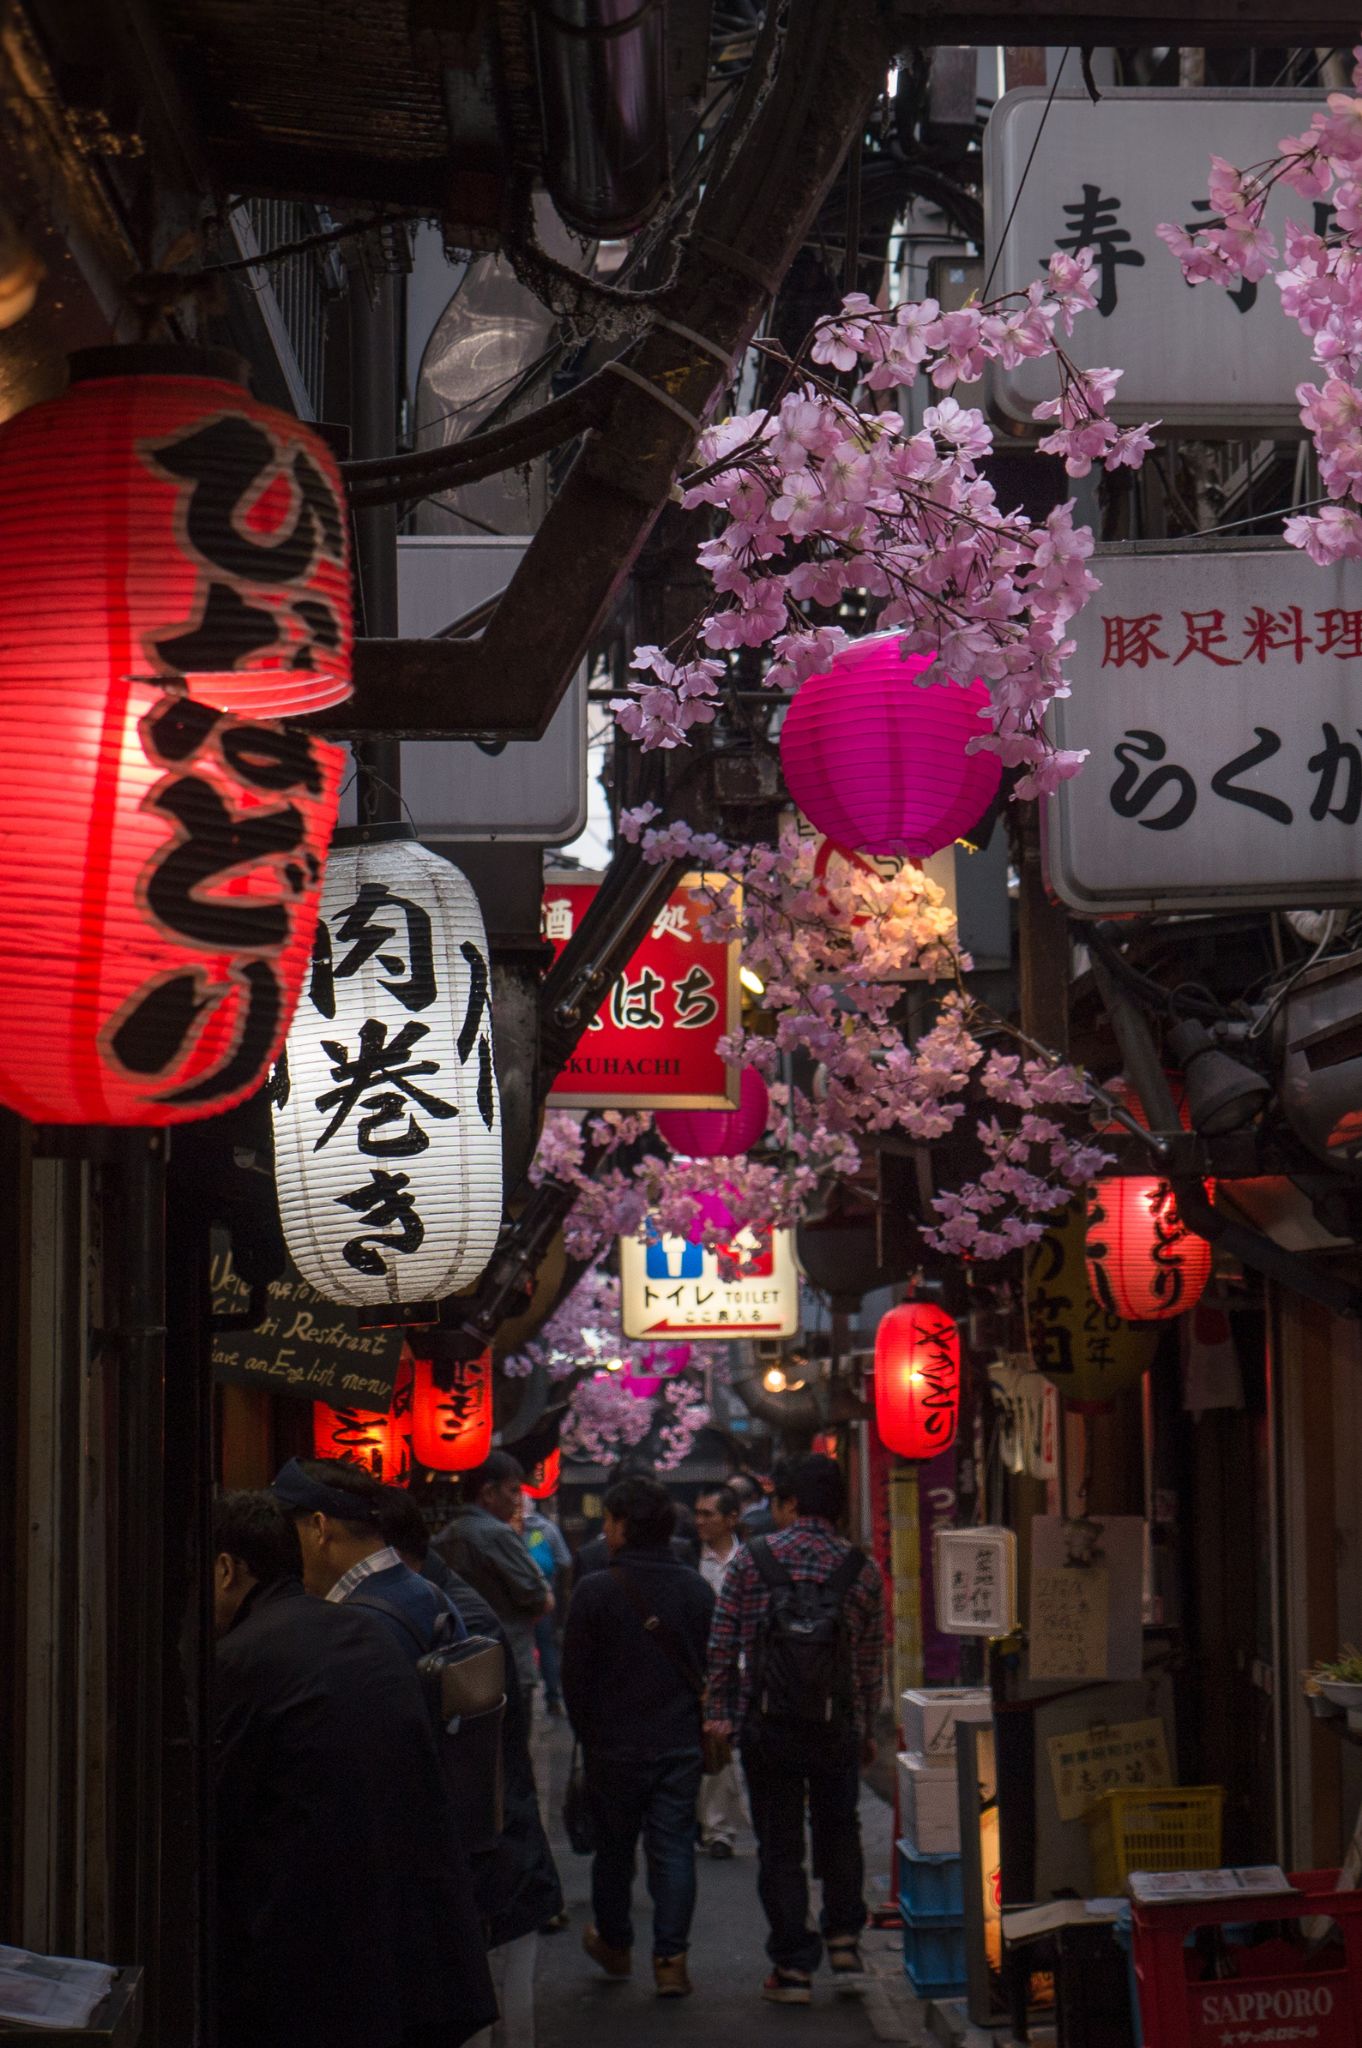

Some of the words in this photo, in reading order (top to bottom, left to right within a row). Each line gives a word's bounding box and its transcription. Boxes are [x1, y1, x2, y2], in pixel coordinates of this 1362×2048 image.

[1101, 605, 1362, 668] 豚足料理
[588, 964, 719, 1031] はち
[311, 882, 461, 1277] 肉巻き
[560, 1057, 682, 1077] KUHACHI
[644, 1285, 714, 1309] トイレ
[725, 1290, 780, 1305] TOILET
[244, 1356, 268, 1372] an
[267, 1348, 337, 1386] English
[1201, 1986, 1335, 2026] SAPPORO
